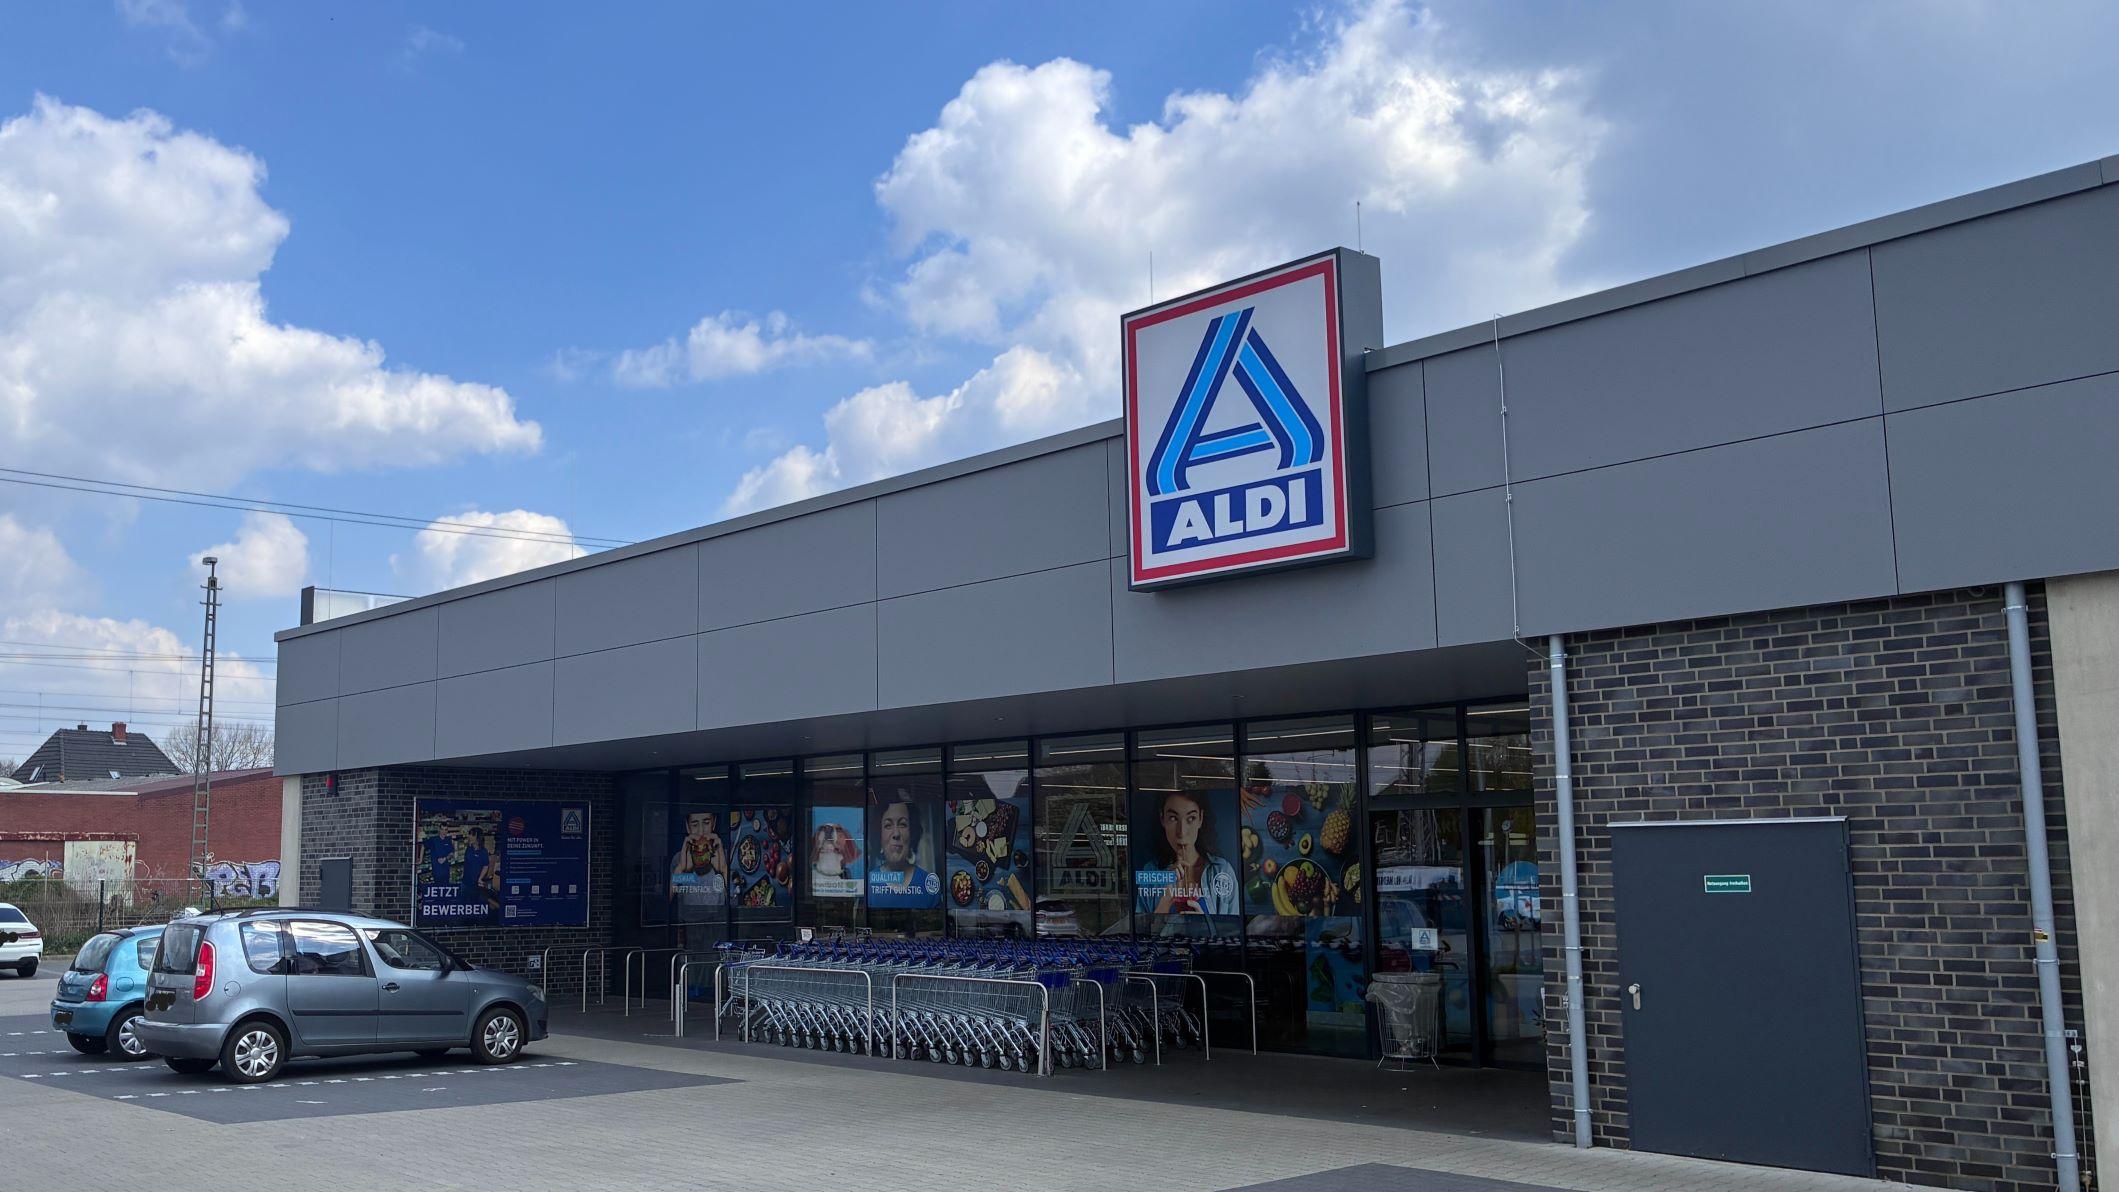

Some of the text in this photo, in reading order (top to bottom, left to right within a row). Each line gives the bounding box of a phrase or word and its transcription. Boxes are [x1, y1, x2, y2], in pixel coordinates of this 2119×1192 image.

[1166, 477, 1307, 547] ALDI
[1059, 870, 1107, 886] ALDI
[1138, 872, 1175, 883] FRISCHE
[424, 886, 460, 898] JETZT
[871, 885, 892, 894] TRIFFT
[1137, 887, 1167, 897] TRIFFT
[423, 904, 489, 916] BEWERBEN
